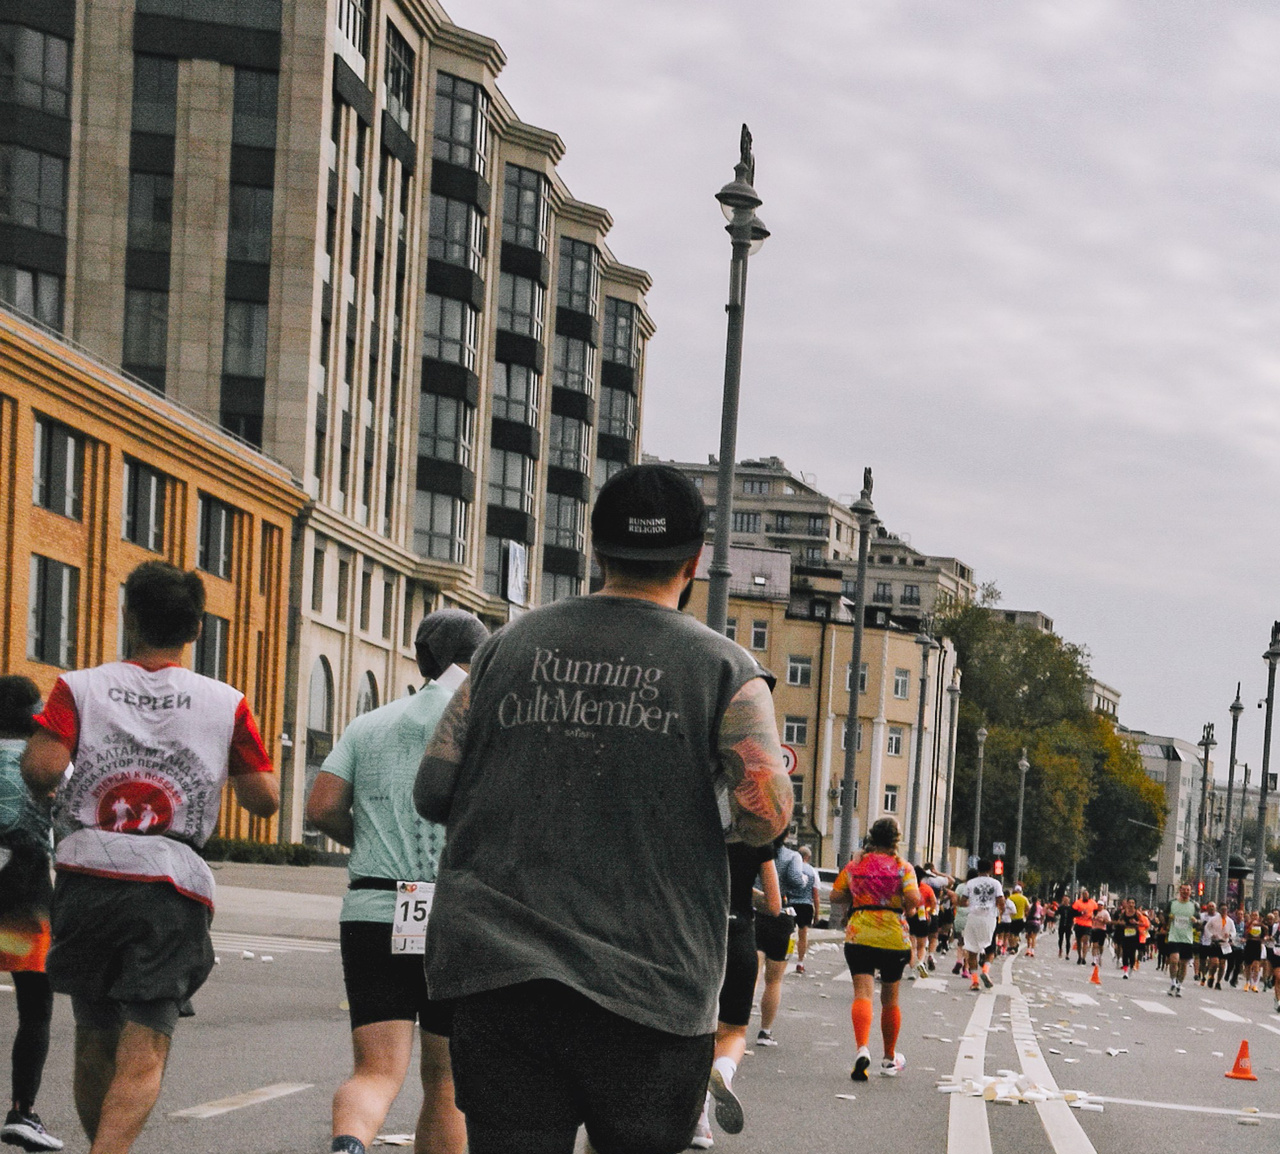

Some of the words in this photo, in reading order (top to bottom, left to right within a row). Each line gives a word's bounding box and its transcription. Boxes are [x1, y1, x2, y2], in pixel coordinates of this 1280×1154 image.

[629, 517, 666, 525] RUNNING
[629, 525, 667, 533] RELIGION
[530, 647, 665, 700] Running
[108, 687, 192, 710] СЕРГЕЙ
[134, 771, 142, 780] К
[400, 901, 428, 922] 15
